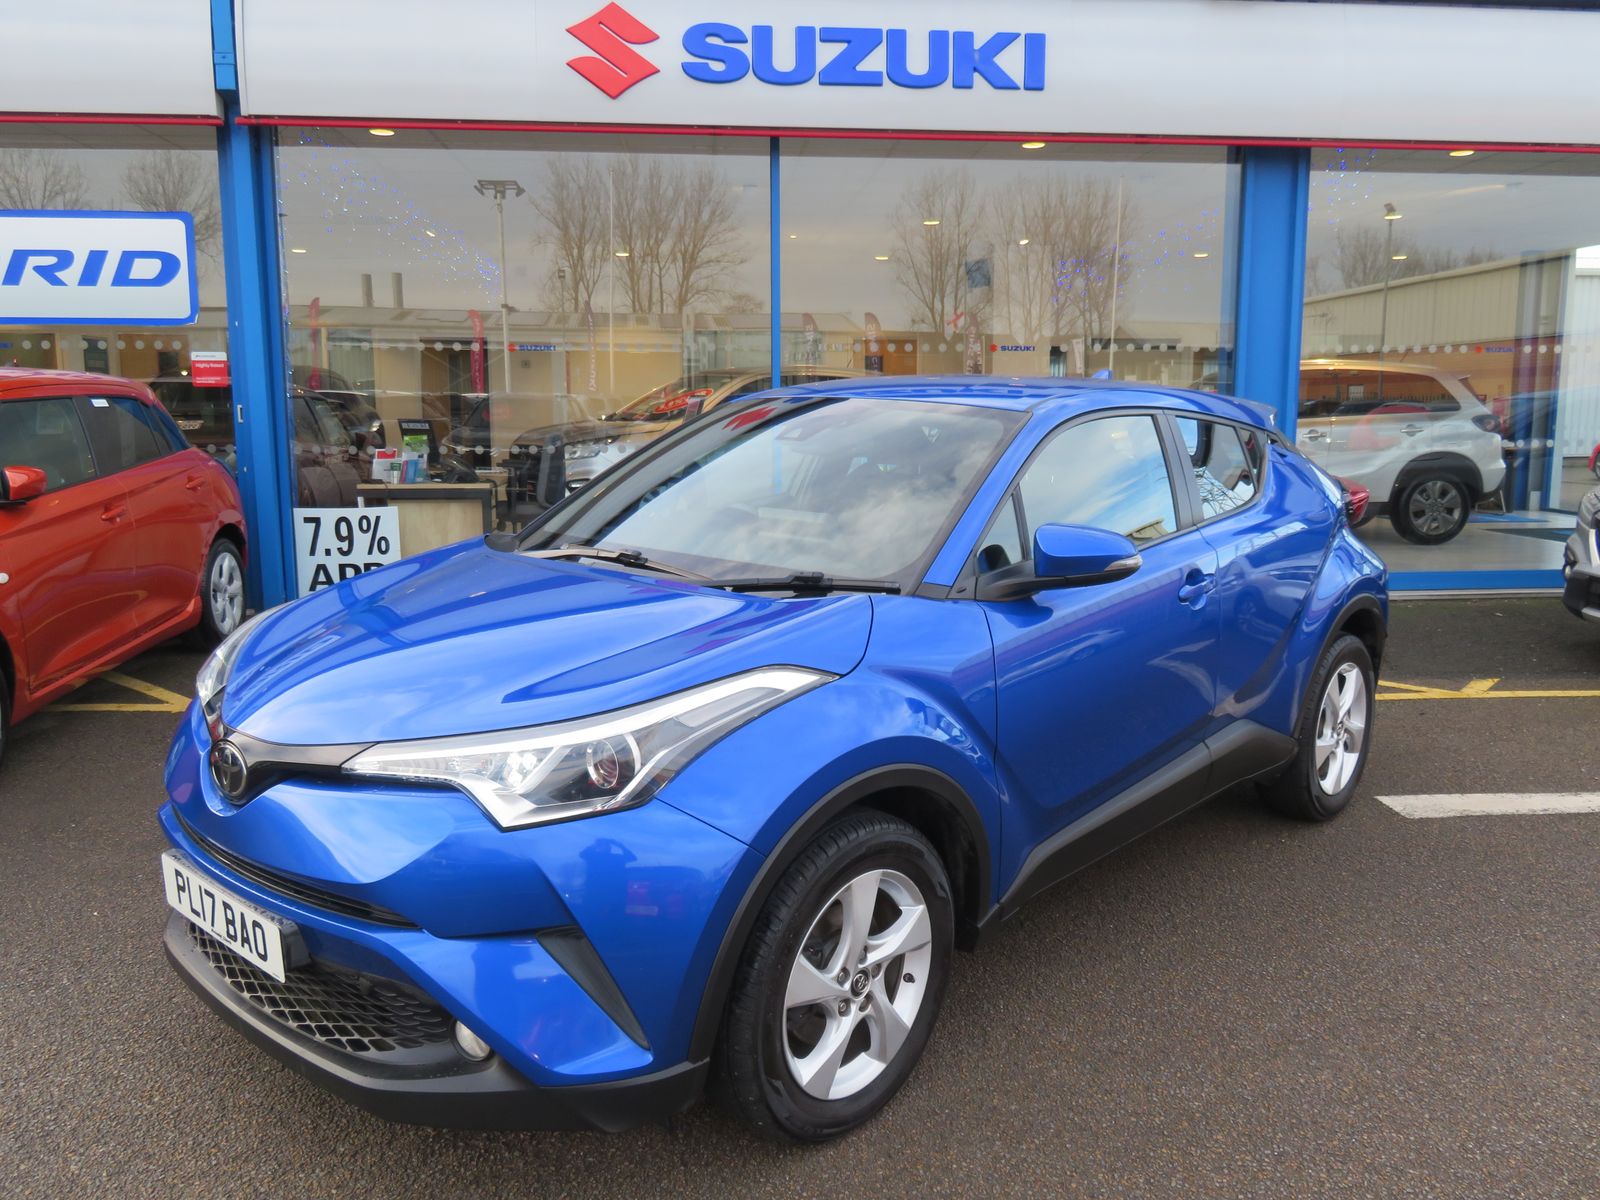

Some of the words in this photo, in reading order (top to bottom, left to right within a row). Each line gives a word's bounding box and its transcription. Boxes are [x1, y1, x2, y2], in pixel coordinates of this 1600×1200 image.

[681, 22, 1047, 91] SUZUKI
[303, 515, 390, 557] 7.9%
[174, 868, 216, 928] PL17
[222, 900, 268, 962] BAO
